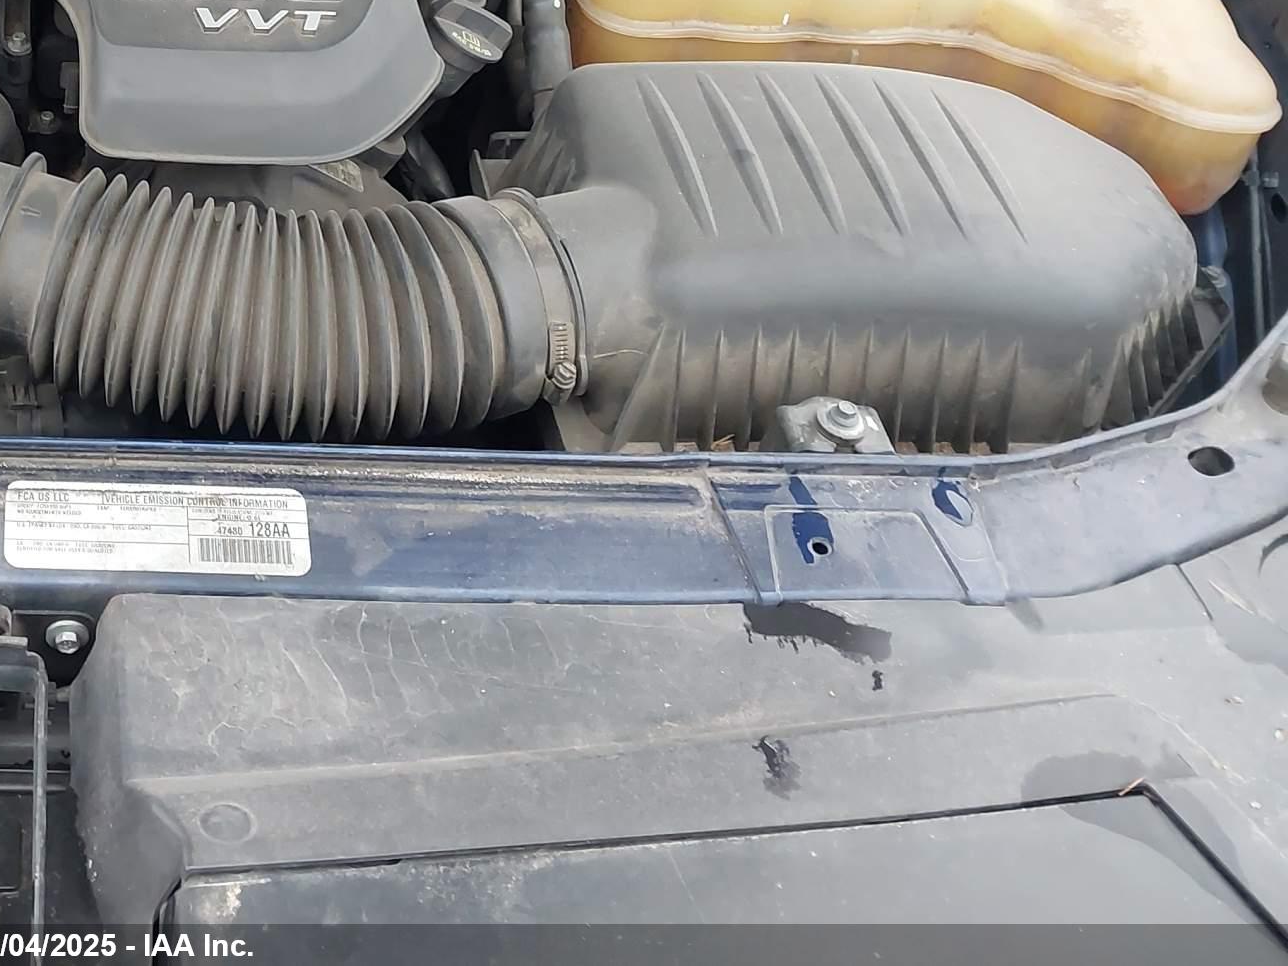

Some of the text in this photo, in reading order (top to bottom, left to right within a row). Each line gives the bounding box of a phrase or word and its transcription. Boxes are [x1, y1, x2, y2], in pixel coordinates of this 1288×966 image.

[195, 6, 338, 34] VVT
[17, 491, 35, 501] FCA
[38, 492, 50, 502] US
[53, 493, 70, 502] LLC
[105, 493, 140, 504] VEHICLE
[143, 494, 184, 506] EMISSION
[187, 497, 225, 506] CONTROL
[229, 498, 288, 509] INFORMATION
[250, 522, 290, 537] 128AA
